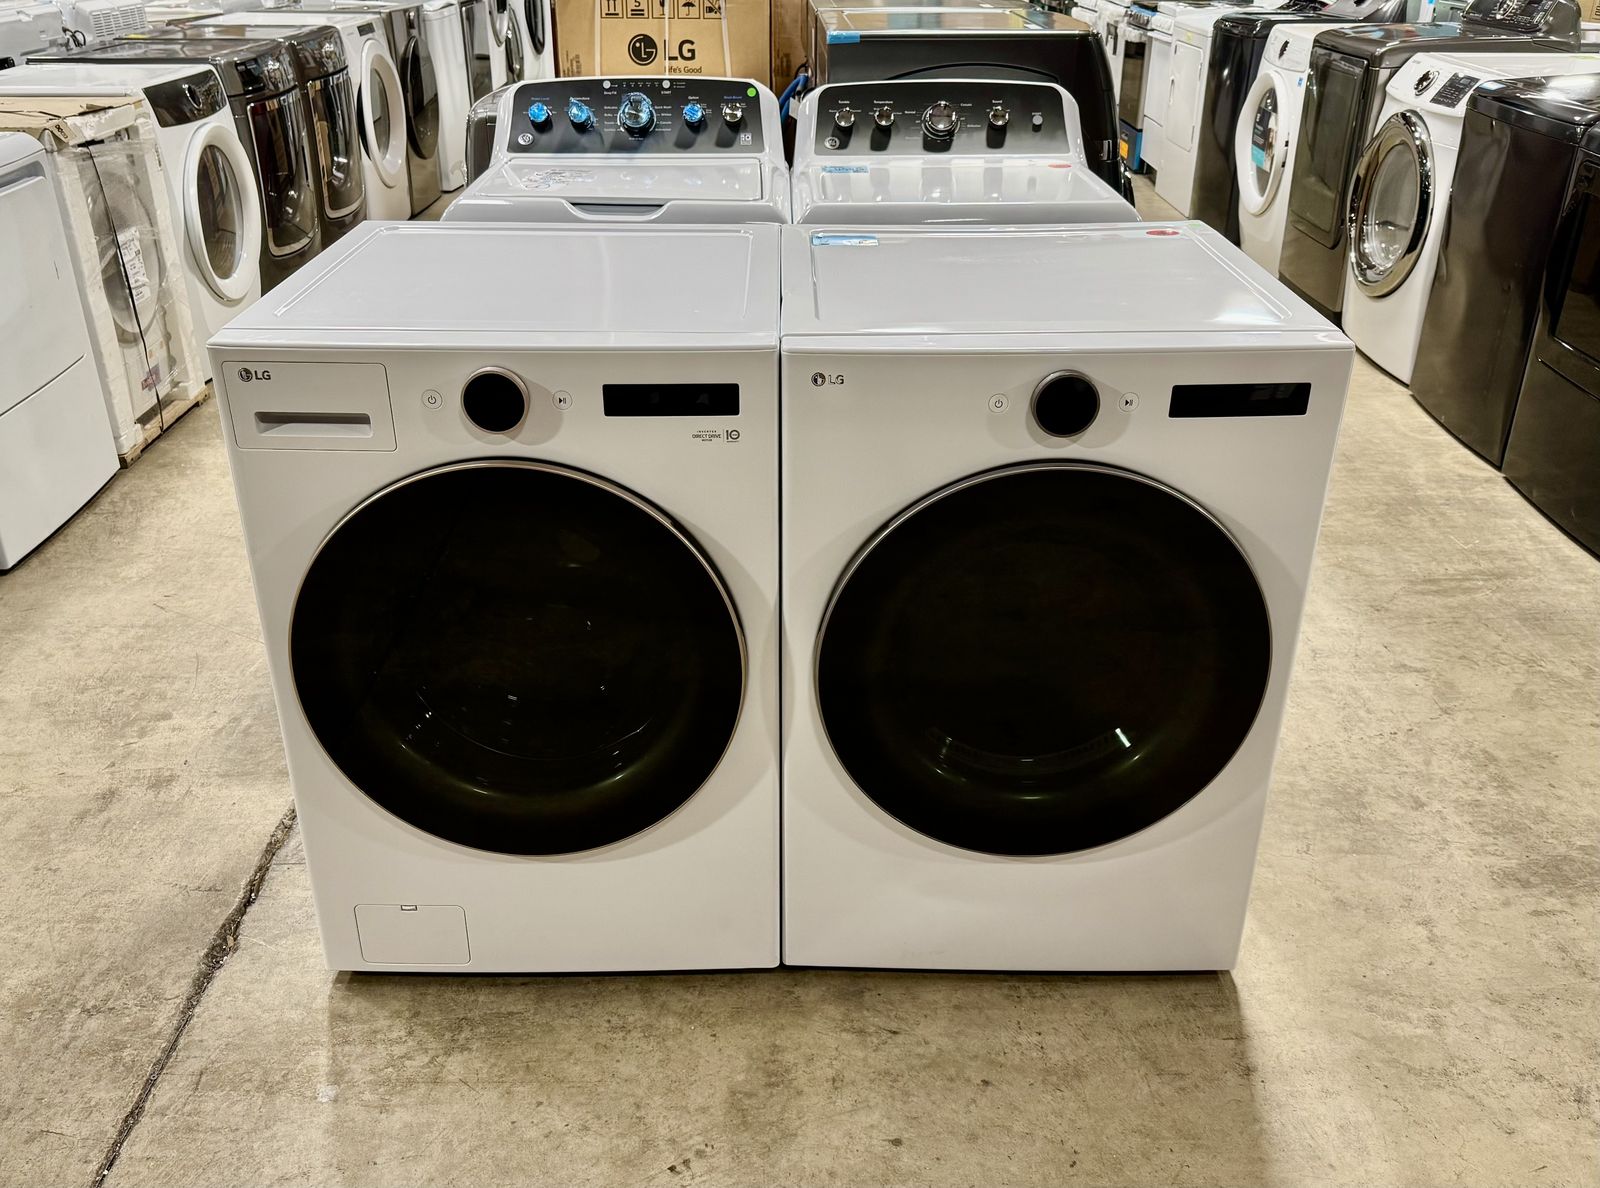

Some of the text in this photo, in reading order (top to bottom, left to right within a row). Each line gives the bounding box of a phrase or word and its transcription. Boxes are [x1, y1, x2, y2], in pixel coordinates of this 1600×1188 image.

[663, 39, 696, 62] LG
[683, 65, 703, 74] Good
[254, 370, 272, 381] LG
[828, 374, 845, 385] LG
